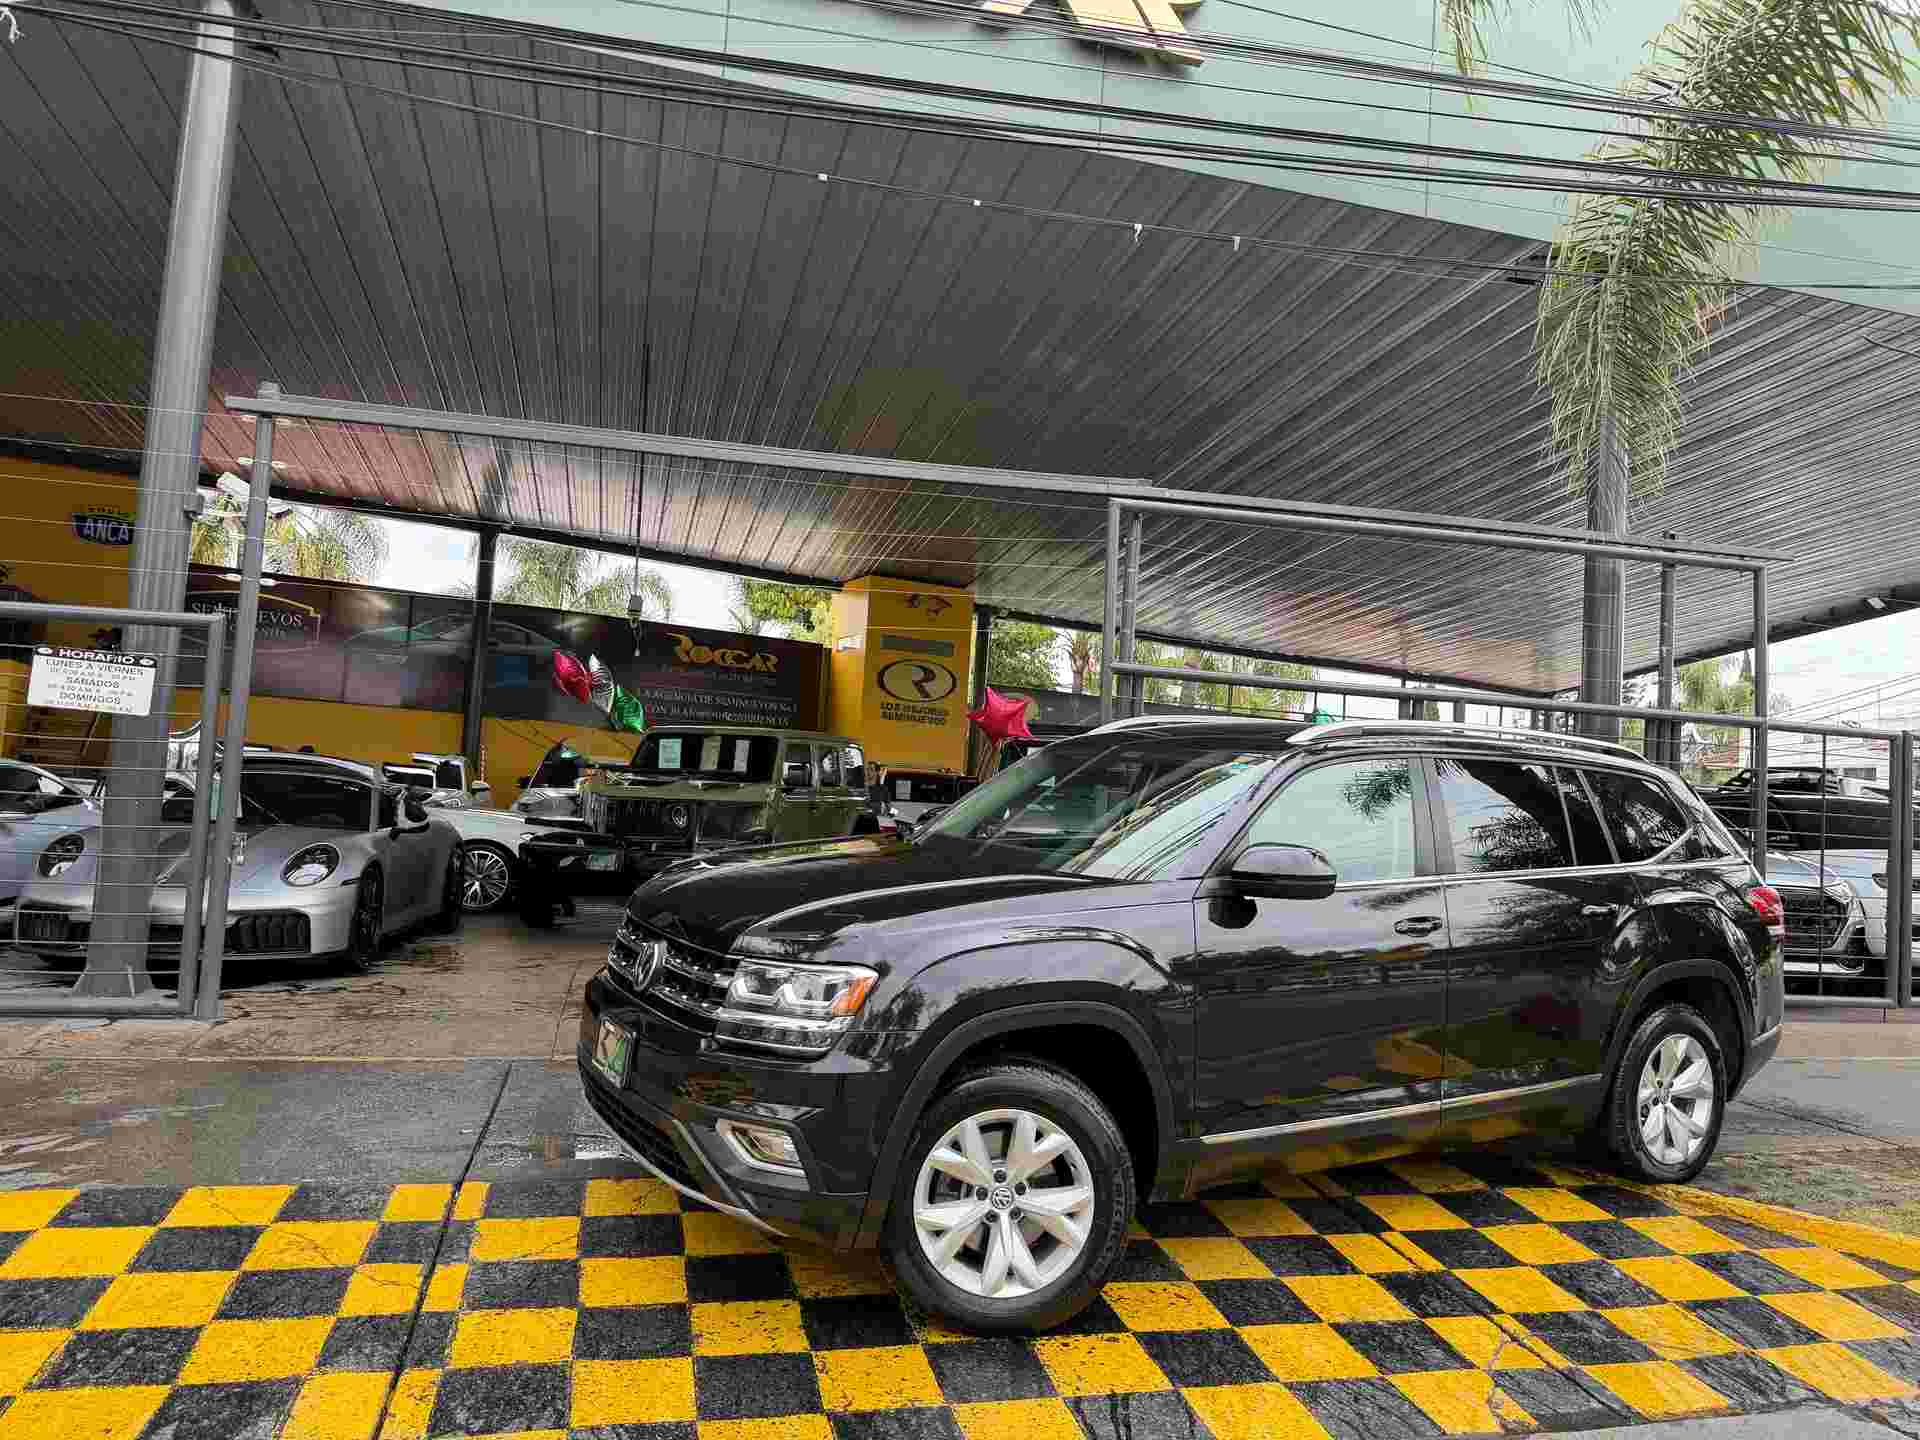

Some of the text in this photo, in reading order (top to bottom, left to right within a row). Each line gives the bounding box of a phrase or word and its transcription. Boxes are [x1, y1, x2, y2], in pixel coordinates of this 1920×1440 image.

[58, 648, 135, 664] HORARIO
[46, 658, 83, 669] LUNES
[86, 662, 94, 670] A
[98, 664, 144, 676] VIERNES
[59, 692, 121, 705] DOMINGOS
